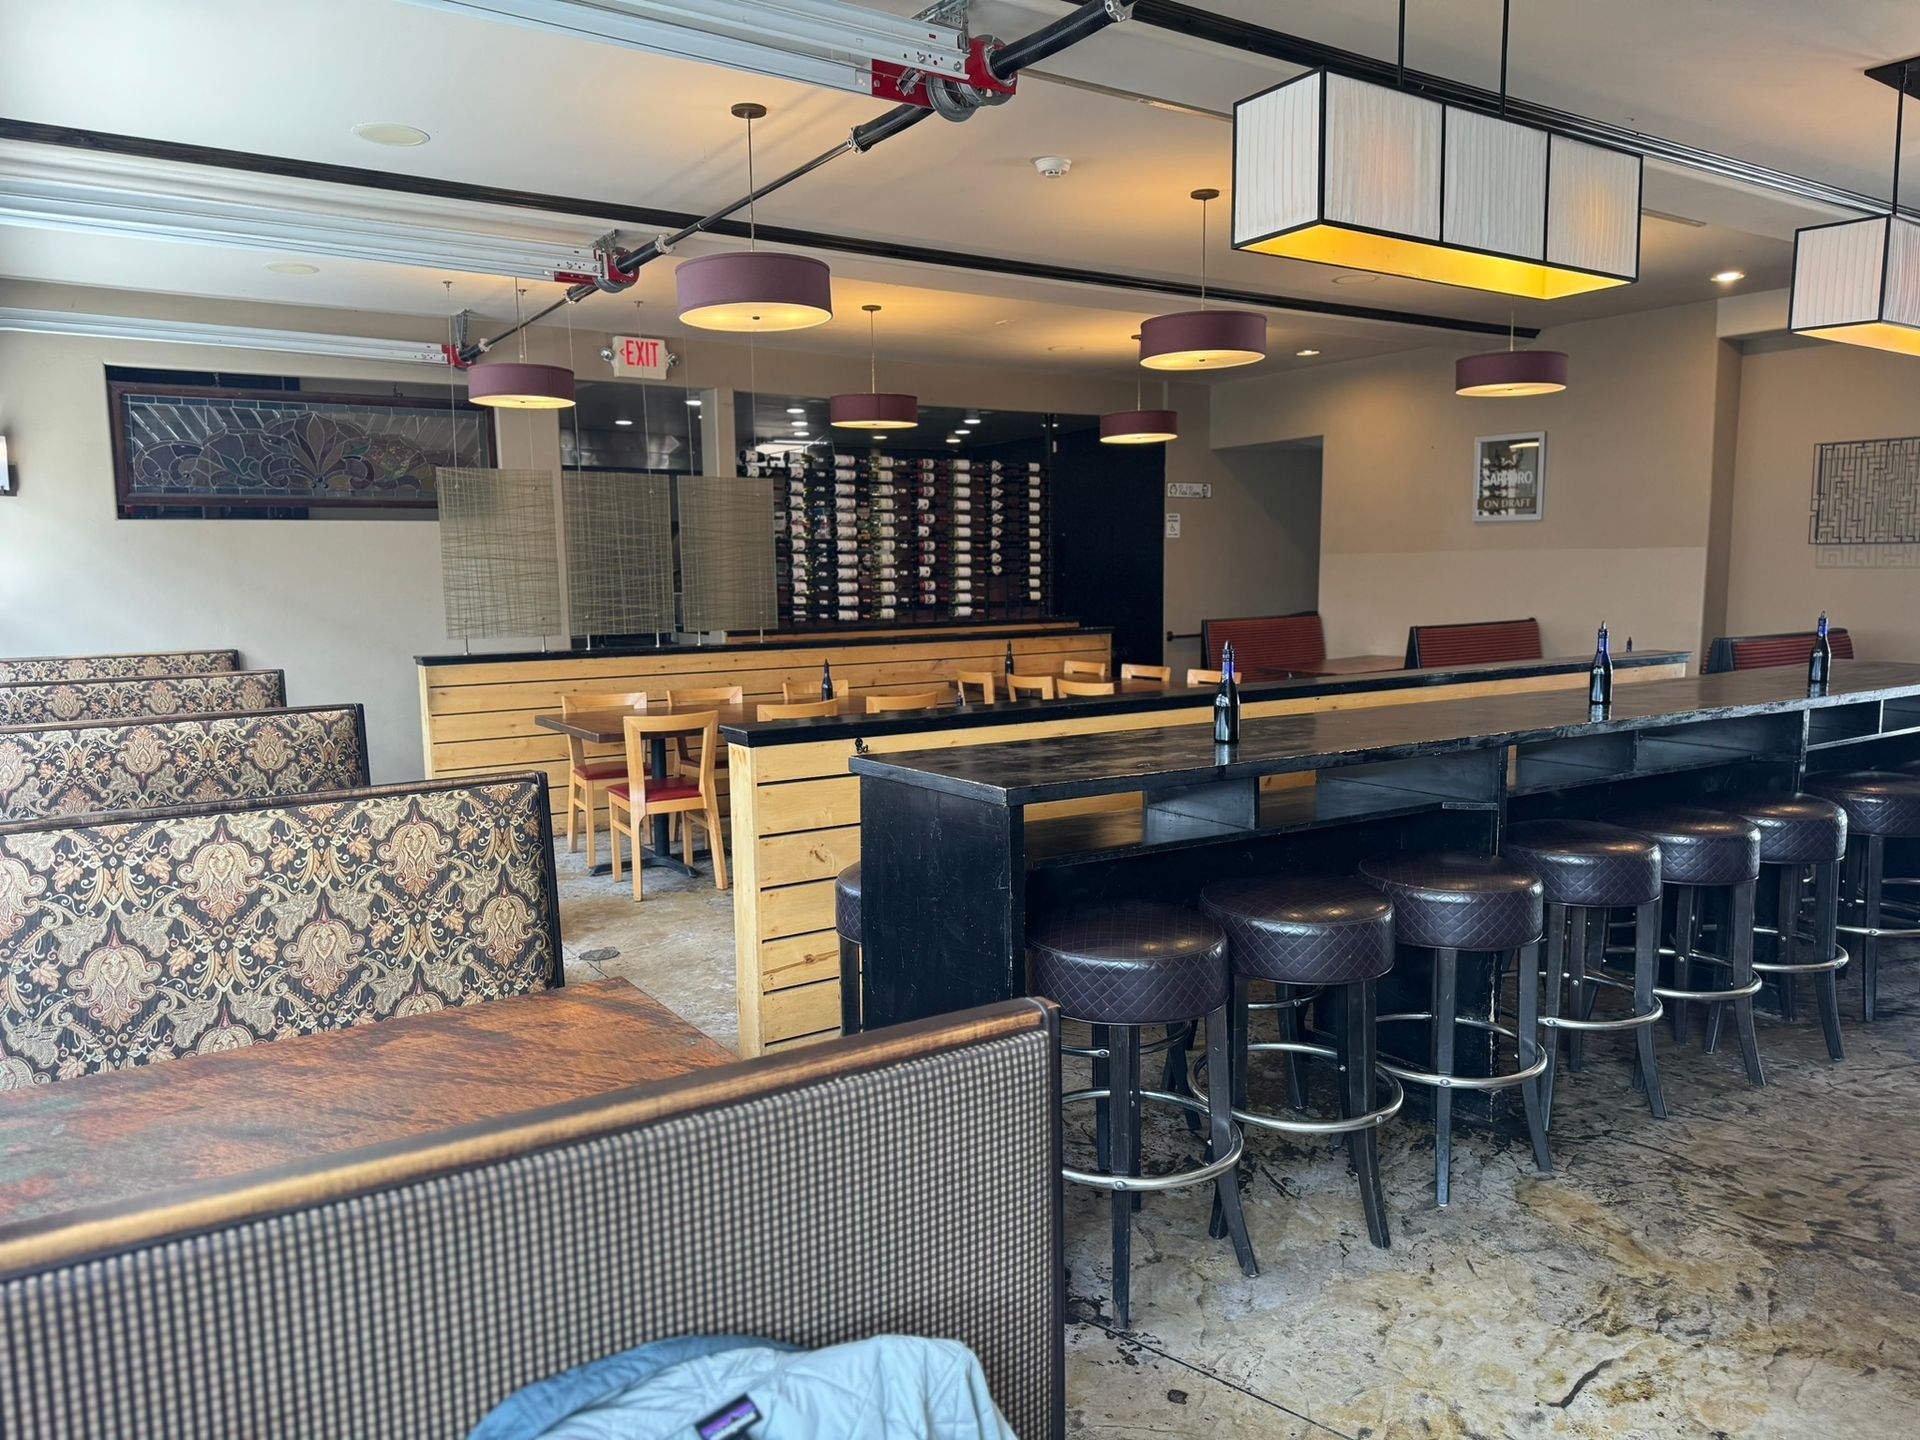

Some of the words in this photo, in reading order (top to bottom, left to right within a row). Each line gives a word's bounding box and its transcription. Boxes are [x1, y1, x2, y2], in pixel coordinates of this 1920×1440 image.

[625, 339, 659, 367] EXIT
[1483, 499, 1500, 508] ON
[1501, 498, 1531, 508] DRAFT
